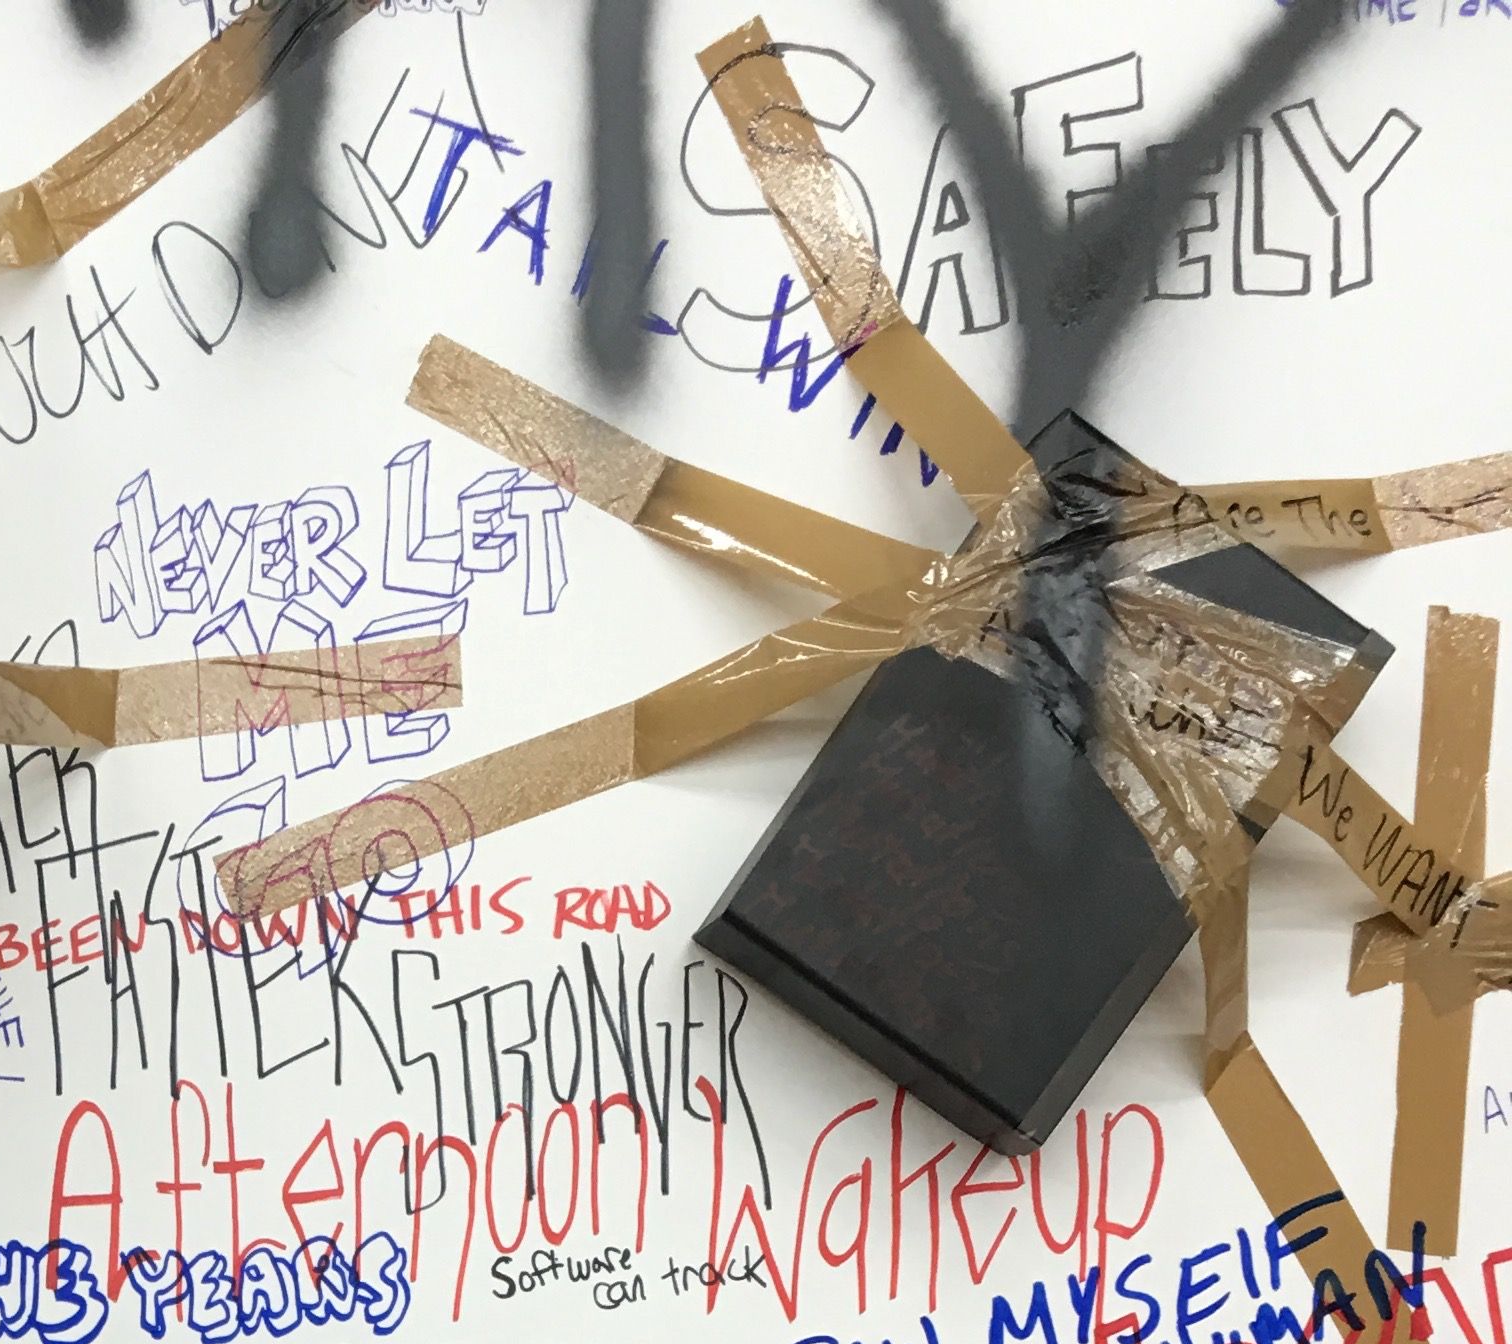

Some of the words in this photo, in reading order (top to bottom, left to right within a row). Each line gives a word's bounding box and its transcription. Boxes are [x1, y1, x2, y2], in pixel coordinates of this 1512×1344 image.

[94, 468, 368, 640] NEVER
[382, 438, 578, 616] LET
[1281, 494, 1373, 537] The
[390, 877, 532, 940] THIS
[551, 876, 675, 942] ROAD
[591, 1278, 649, 1311] can
[659, 1244, 769, 1298] track
